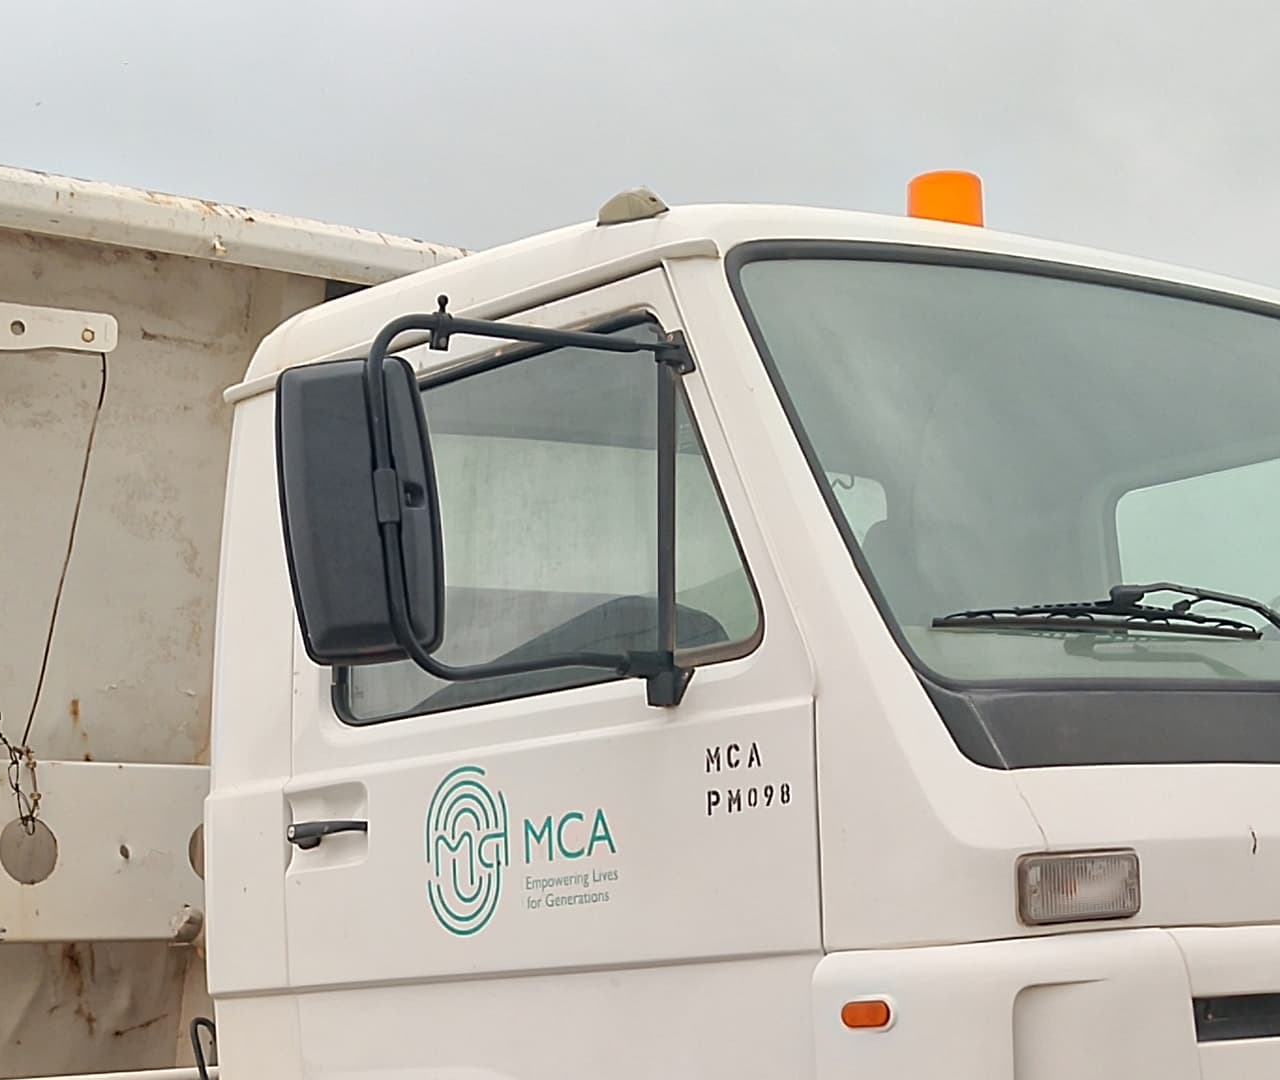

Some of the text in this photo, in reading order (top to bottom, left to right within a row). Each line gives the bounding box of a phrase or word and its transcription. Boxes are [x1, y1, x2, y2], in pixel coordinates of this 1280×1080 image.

[706, 742, 761, 773] MCA
[707, 783, 790, 816] PM098
[523, 808, 617, 864] MCA
[525, 868, 619, 892] Empowering Lives
[527, 891, 610, 909] for Generations
